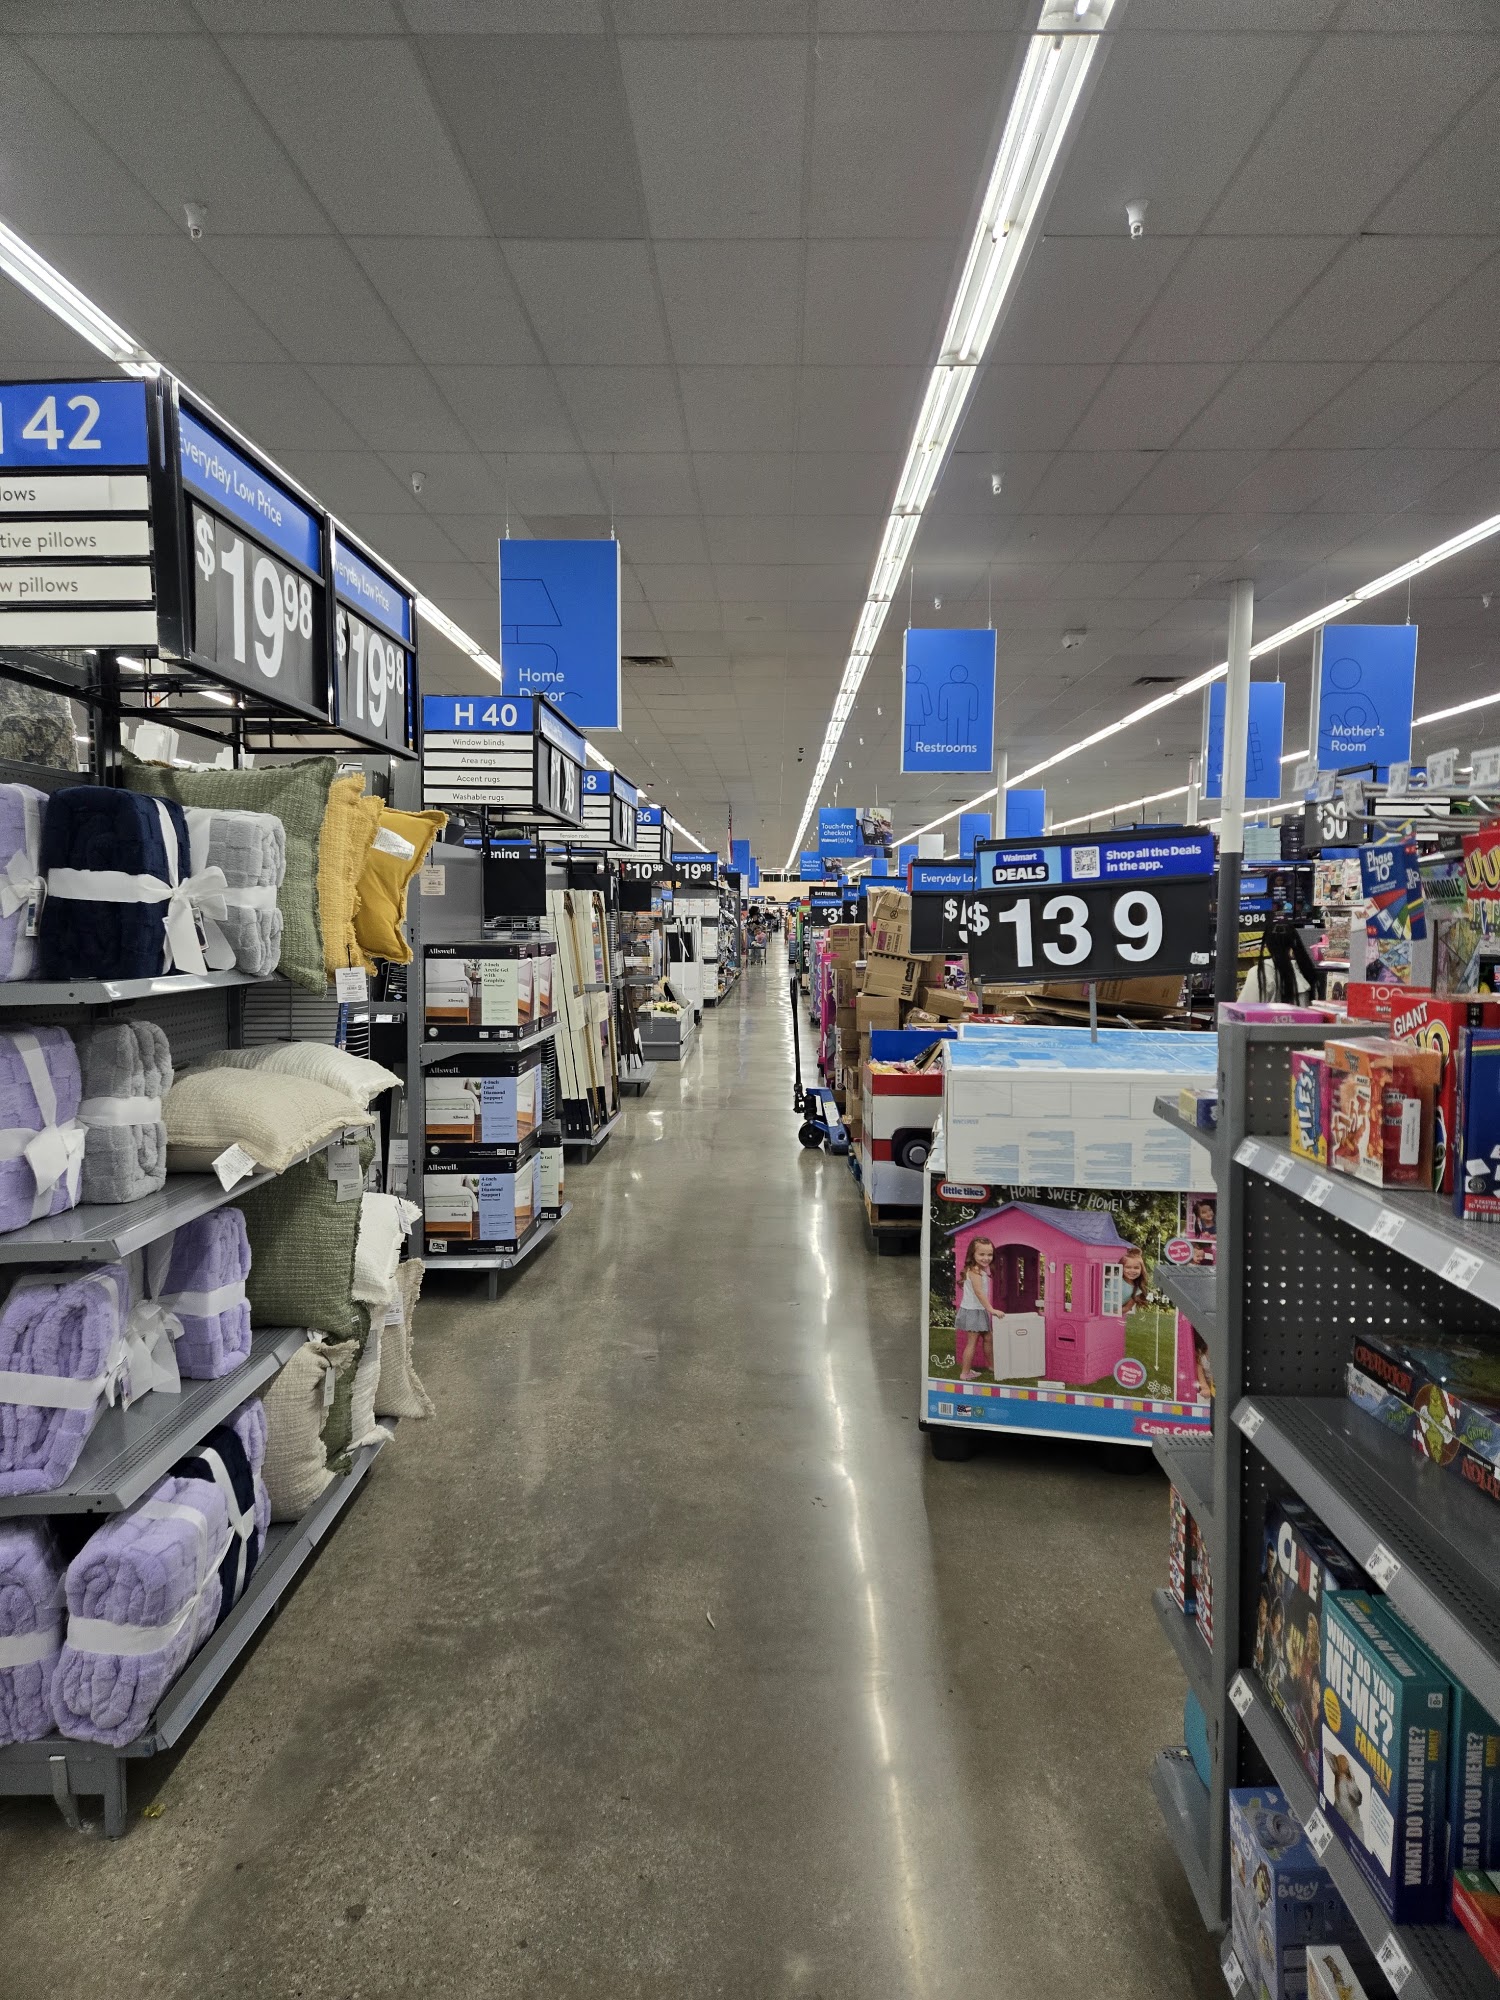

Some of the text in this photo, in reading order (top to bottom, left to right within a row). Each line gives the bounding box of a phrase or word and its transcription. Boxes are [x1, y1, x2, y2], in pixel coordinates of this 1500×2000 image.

[22, 395, 102, 450] 42
[234, 469, 255, 507] Low
[257, 489, 283, 527] Price
[37, 531, 98, 553] pillows
[19, 577, 79, 597] pillows
[334, 560, 390, 612] veryday Low Price
[518, 667, 565, 683] Home
[518, 687, 566, 702] Dcor
[454, 703, 474, 726] H
[481, 703, 518, 727] 40
[1331, 725, 1385, 738] Mother's
[452, 738, 505, 746] Window blinds
[915, 741, 978, 753] Restrooms
[1331, 740, 1367, 753] Room
[460, 756, 496, 767] Area rugs
[456, 774, 501, 785] Accent rugs
[452, 793, 505, 803] Washable rugs
[636, 810, 652, 823] 36
[821, 822, 854, 831] Touch-free
[1002, 852, 1038, 863] Walmart
[1106, 844, 1202, 860] Shop all the Deals
[1366, 849, 1394, 867] Phase
[995, 865, 1046, 882] DEALS
[1106, 860, 1164, 874] in the app.
[1375, 863, 1390, 882] 10
[921, 873, 962, 886] Everyday
[1422, 878, 1465, 900] KANOODLE
[1393, 1001, 1429, 1038] GIANT
[942, 1186, 985, 1198] little tikes
[1010, 1185, 1124, 1212] HOME SWEET HOME!
[1141, 1422, 1170, 1436] Cape
[1277, 1521, 1320, 1603] CLUE
[1326, 1613, 1395, 1716] WHAT DO YOU
[1325, 1639, 1394, 1758] MEME?
[1355, 1725, 1393, 1792] FAMILY
[1465, 1732, 1484, 1786] MEME?
[1404, 1726, 1426, 1885] WHAT DO YOU MEME?
[1464, 1788, 1483, 1820] YOU
[1463, 1822, 1481, 1844] DO
